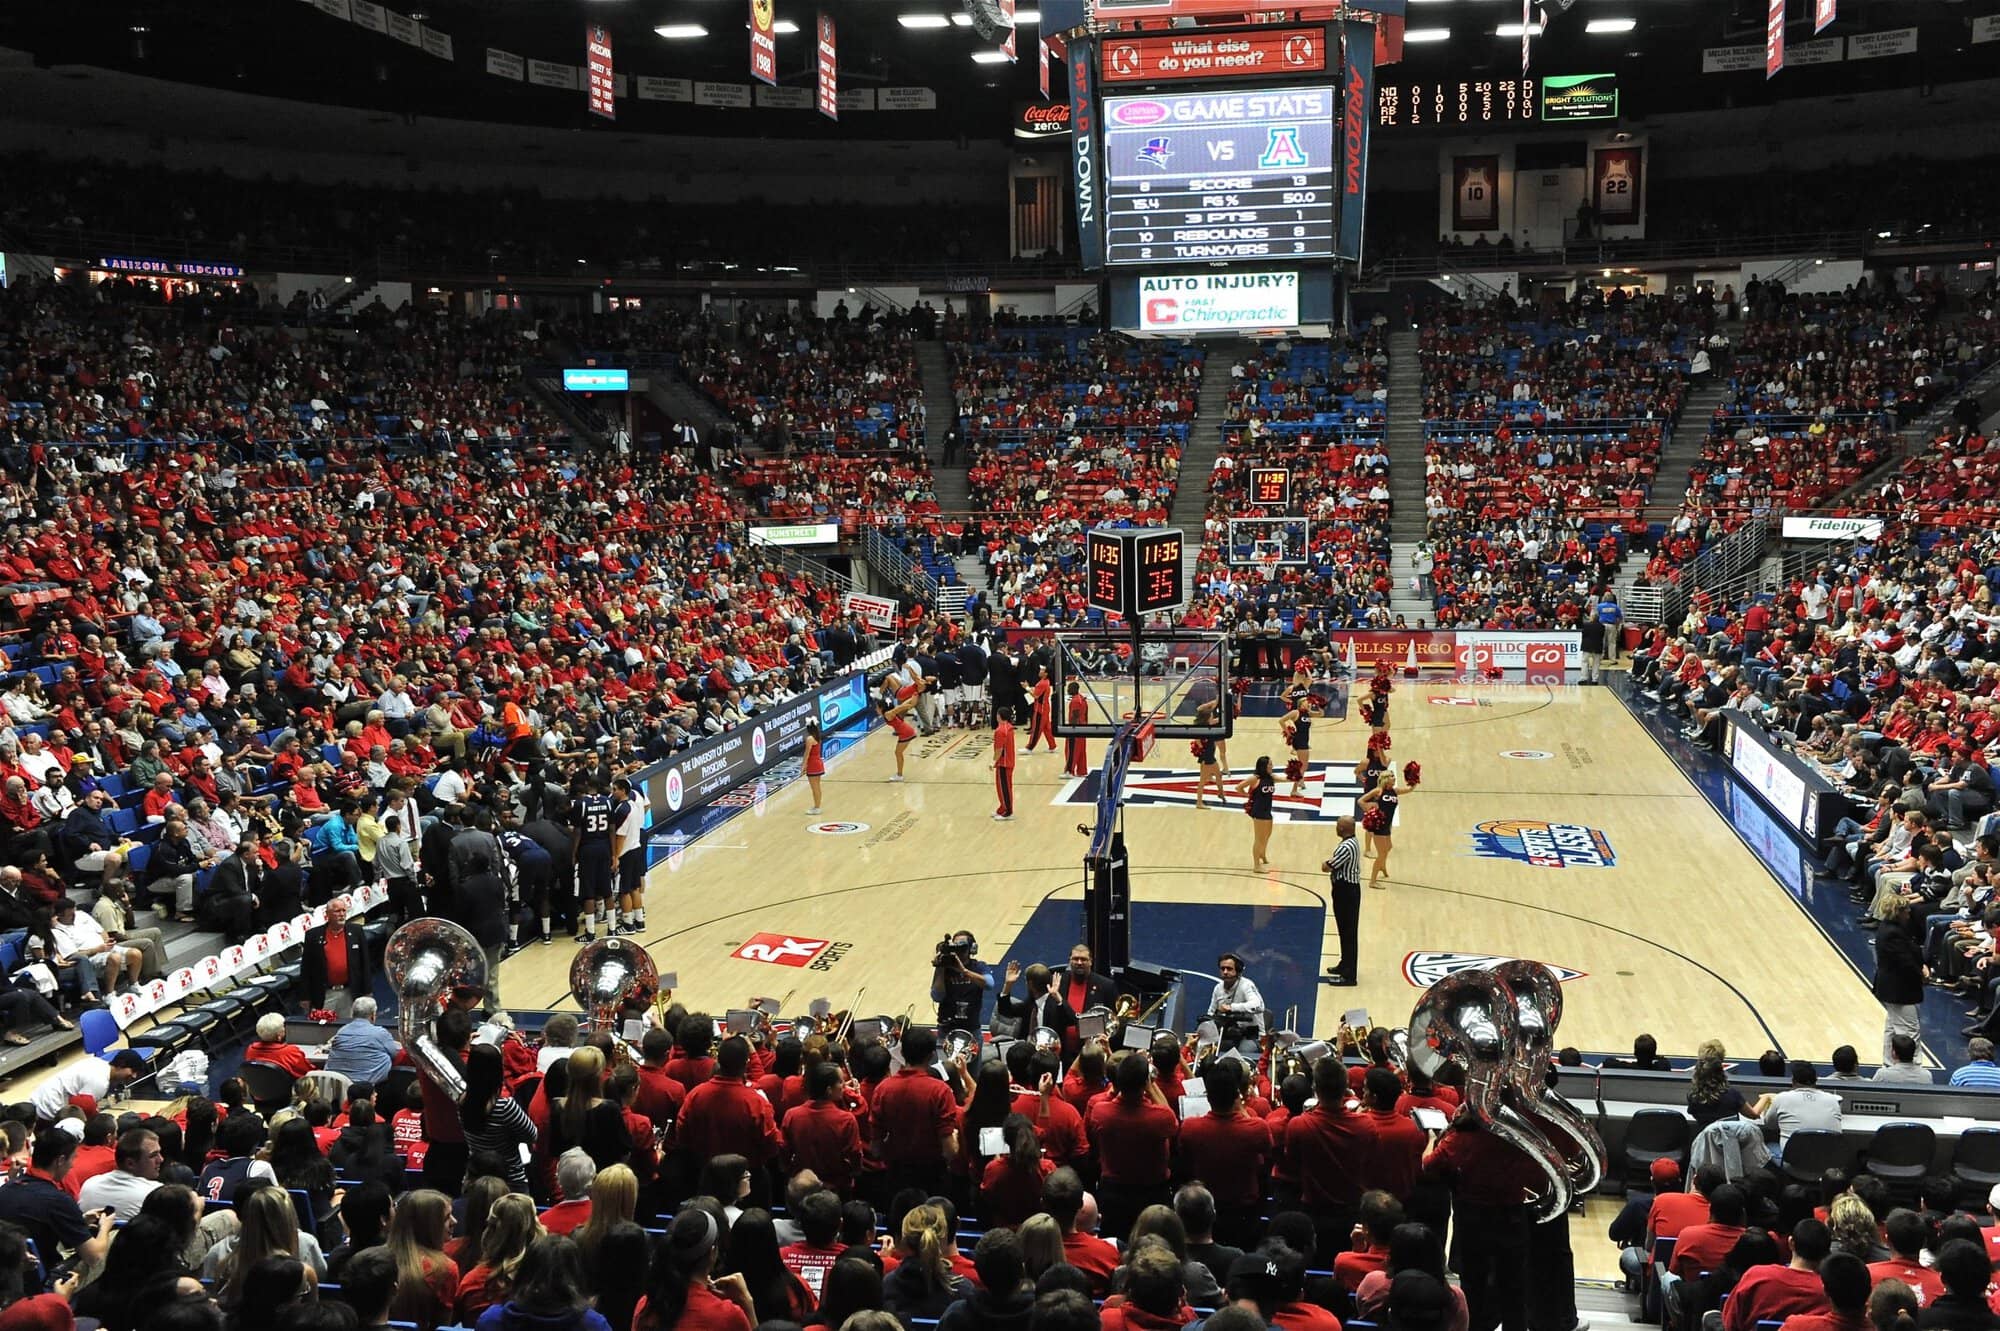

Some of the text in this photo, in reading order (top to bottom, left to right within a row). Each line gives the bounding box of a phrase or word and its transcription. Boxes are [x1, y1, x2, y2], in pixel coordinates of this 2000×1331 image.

[1172, 39, 1250, 55] What else
[756, 52, 771, 74] 1988
[1159, 52, 1264, 72] do you need?
[1475, 82, 1492, 92] 20
[1499, 81, 1516, 91] 22
[1173, 94, 1322, 120] GAME STATS
[1379, 96, 1399, 107] PTS
[1545, 95, 1613, 105] BRIGHT SOLUTIONS
[1381, 106, 1397, 115] RB
[1034, 122, 1063, 131] zero.
[1346, 64, 1365, 194] ARIZONA
[1380, 116, 1397, 125] FL
[1207, 141, 1235, 162] VS
[1258, 126, 1309, 170] A
[1189, 178, 1253, 192] SCORE
[1291, 175, 1307, 187] 13
[1605, 180, 1628, 194] 22
[1132, 193, 1316, 210] 15.4 FG % 50.0
[1468, 187, 1483, 201] 10
[1143, 210, 1303, 227] 1 3 PTS 1
[1138, 226, 1305, 243] 10 REBOUNDS 8
[1141, 242, 1305, 259] 2 TURNOVERS 3
[112, 259, 234, 276] ARIZONA WILDCATS
[1143, 274, 1296, 292] AUTO INJURY?
[1182, 306, 1288, 324] Chiropractic
[1257, 473, 1285, 483] 11:35
[1260, 485, 1281, 499] 35
[1809, 520, 1866, 532] Fidelity
[1094, 543, 1119, 565] 11:35
[1145, 541, 1179, 565] 11:35
[1148, 569, 1174, 601] 35
[848, 598, 890, 617] ESPN
[1338, 642, 1393, 654] WELLS
[1531, 649, 1560, 664] GO
[681, 761, 692, 775] THE
[691, 748, 717, 770] UNIVERSITY
[722, 737, 743, 755] ARIZONA
[701, 757, 728, 778] PHYSICIANS
[587, 814, 608, 832] 35
[1518, 828, 1559, 859] SPORTS
[1549, 824, 1604, 866] CLASSIC
[740, 938, 825, 962] 2K
[809, 941, 853, 972] SPORTS
